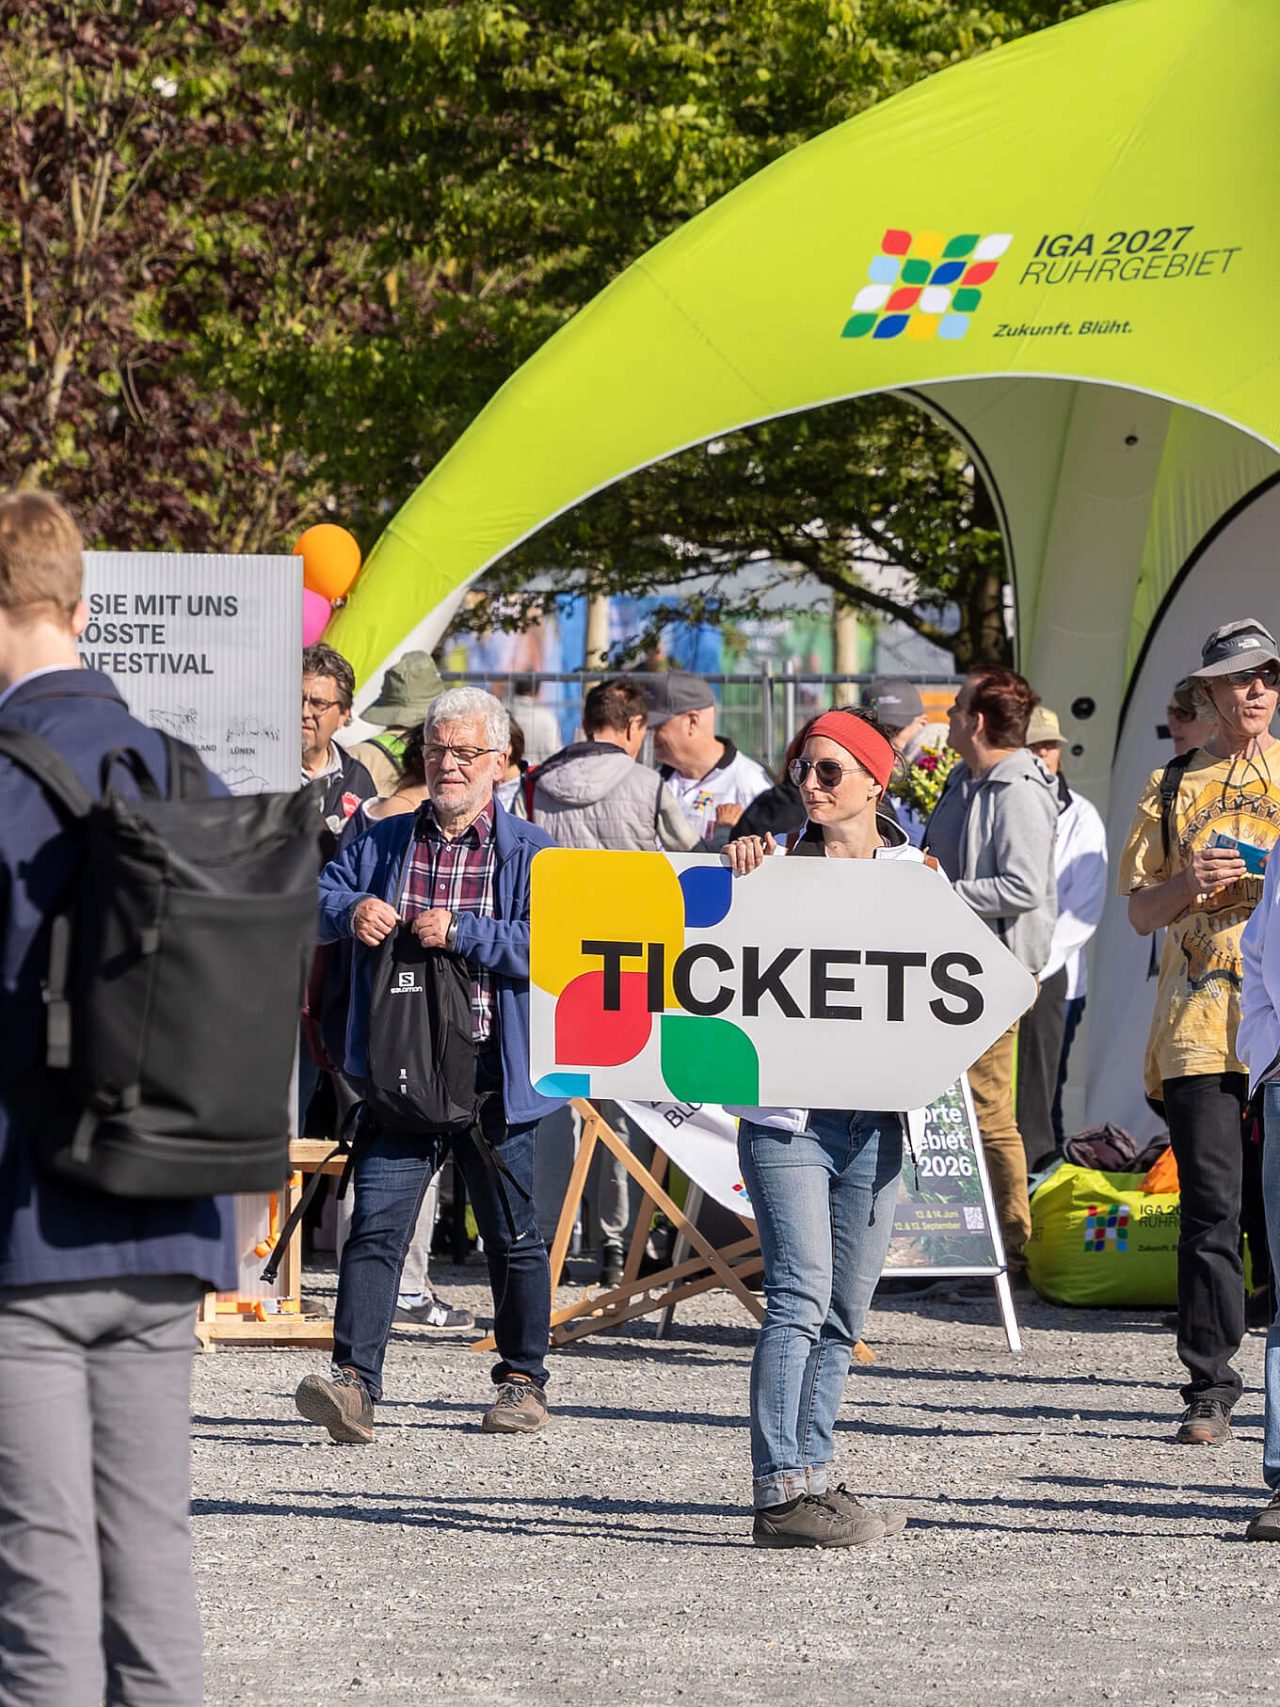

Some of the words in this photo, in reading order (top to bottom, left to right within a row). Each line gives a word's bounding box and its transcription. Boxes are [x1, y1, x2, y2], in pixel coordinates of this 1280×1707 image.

[1033, 233, 1095, 258] IGA
[1102, 226, 1195, 255] 2027
[1019, 247, 1243, 286] RUHRGEBIET
[992, 321, 1074, 338] Zukunft.
[1078, 319, 1133, 337] Blüht.
[89, 593, 128, 615] SIE
[134, 594, 182, 616] MIT
[187, 595, 238, 617] UNS
[78, 617, 166, 645] ÖSSTE
[230, 746, 256, 755] LÜNEN
[581, 939, 985, 1026] TICKETS
[920, 1155, 973, 1177] 2026
[1140, 1204, 1163, 1216] IGA
